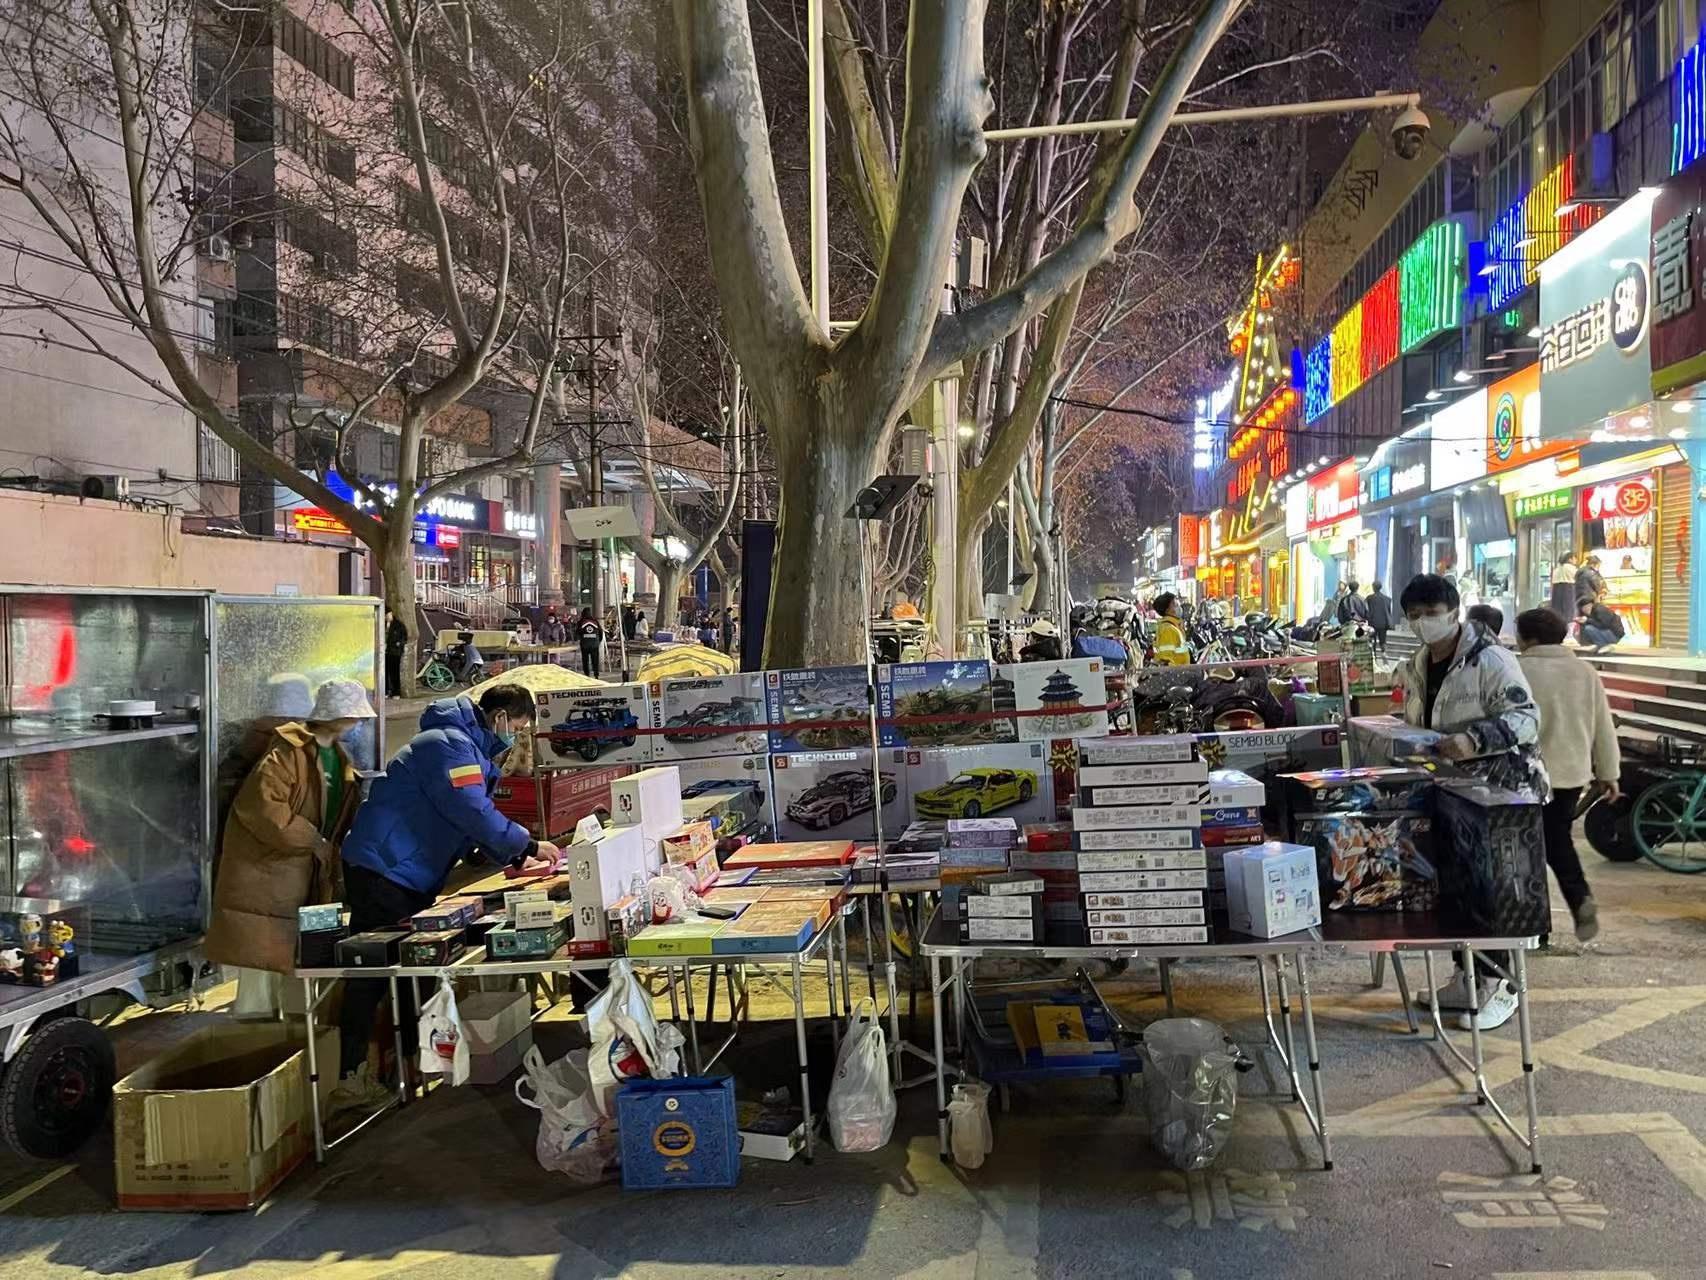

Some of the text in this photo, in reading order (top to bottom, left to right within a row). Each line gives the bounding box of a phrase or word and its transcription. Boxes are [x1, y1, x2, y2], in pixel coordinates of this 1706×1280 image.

[652, 700, 662, 728] SEMB
[880, 684, 892, 718] SEMB
[1228, 733, 1297, 749] SEMBO BLOCK
